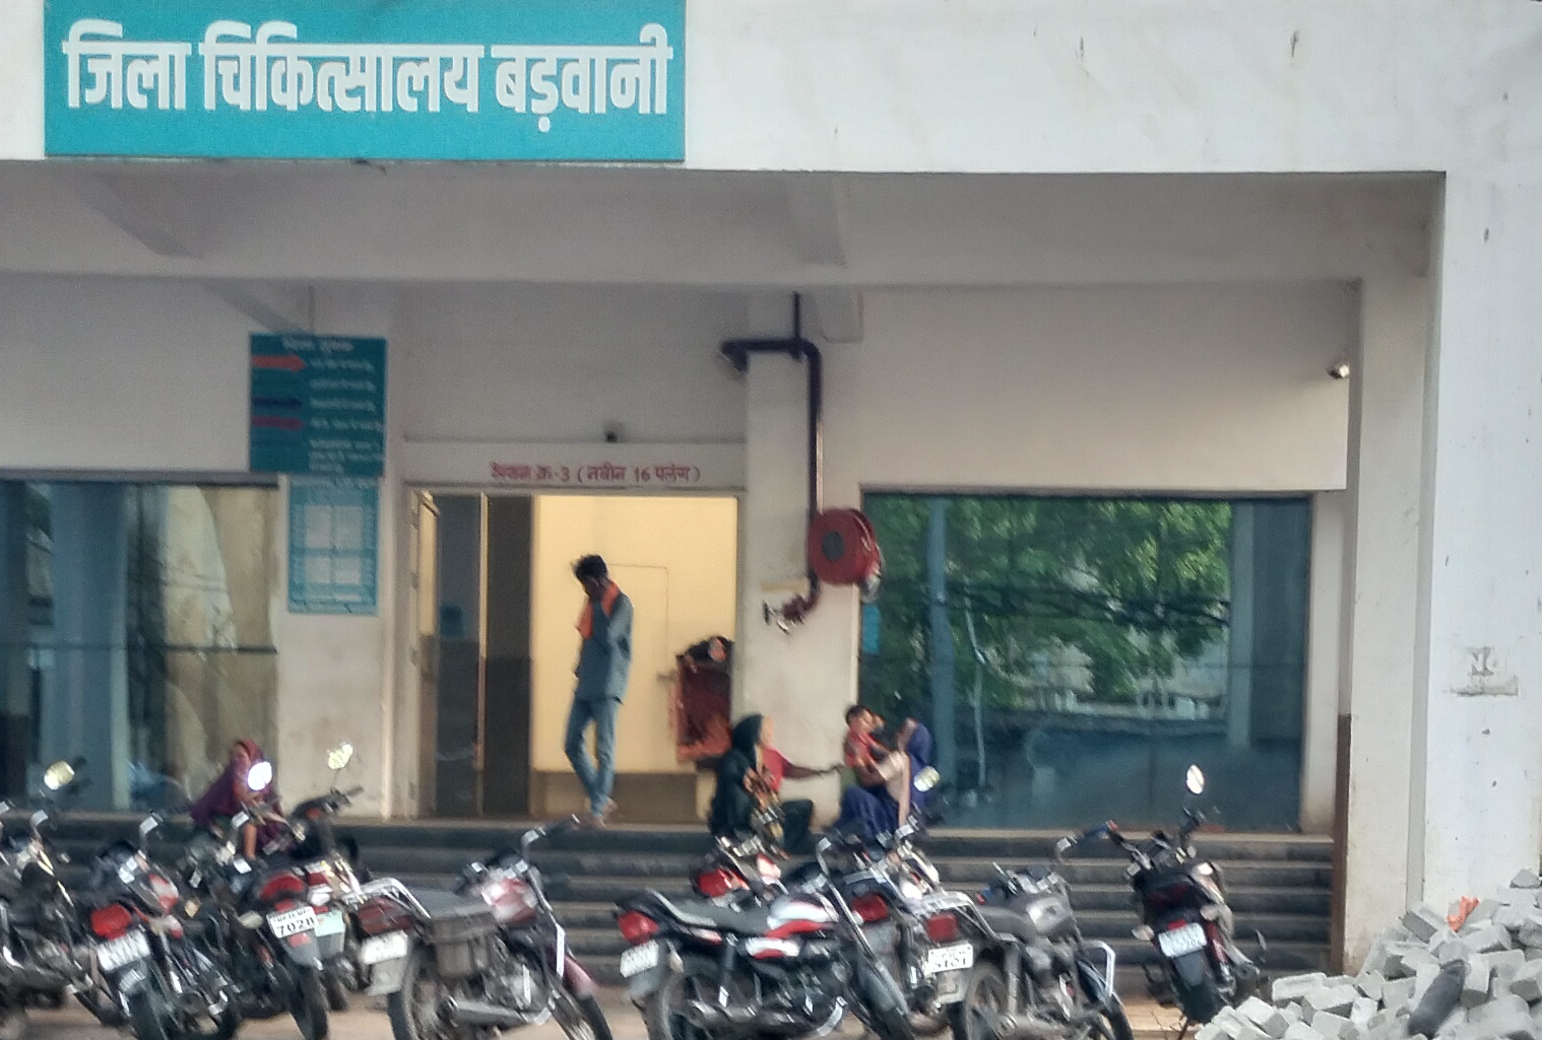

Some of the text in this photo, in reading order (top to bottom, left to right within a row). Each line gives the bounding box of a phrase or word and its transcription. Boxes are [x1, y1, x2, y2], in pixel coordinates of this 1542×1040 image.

[62, 18, 674, 133] जिला चिकित्सालय बड़वानी
